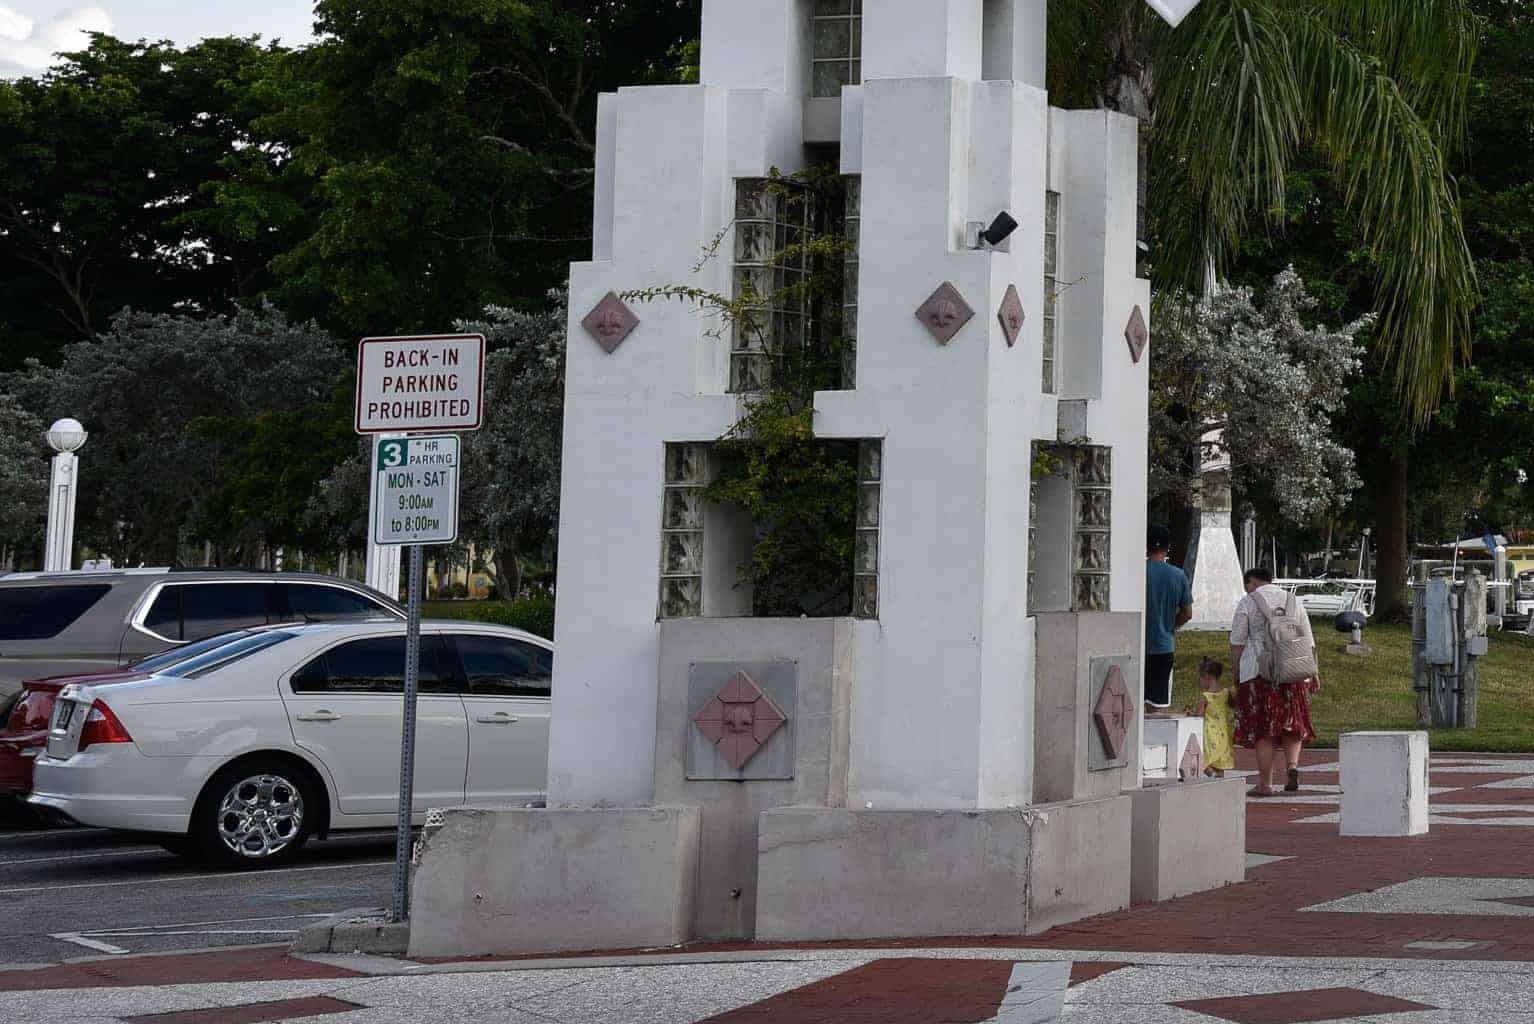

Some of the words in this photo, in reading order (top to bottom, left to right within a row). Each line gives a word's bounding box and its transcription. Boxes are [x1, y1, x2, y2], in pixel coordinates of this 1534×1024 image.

[384, 349, 459, 368] BACK-IN
[383, 375, 458, 393] PARKING
[368, 399, 470, 420] PROHIBITED
[384, 443, 402, 466] 3
[424, 441, 438, 451] HR
[410, 454, 453, 465] PARKING
[388, 473, 414, 489] MON
[423, 471, 447, 487] SAT
[399, 495, 433, 510] 9:00AM
[392, 519, 402, 532] to
[405, 516, 439, 531] 8:00PM
